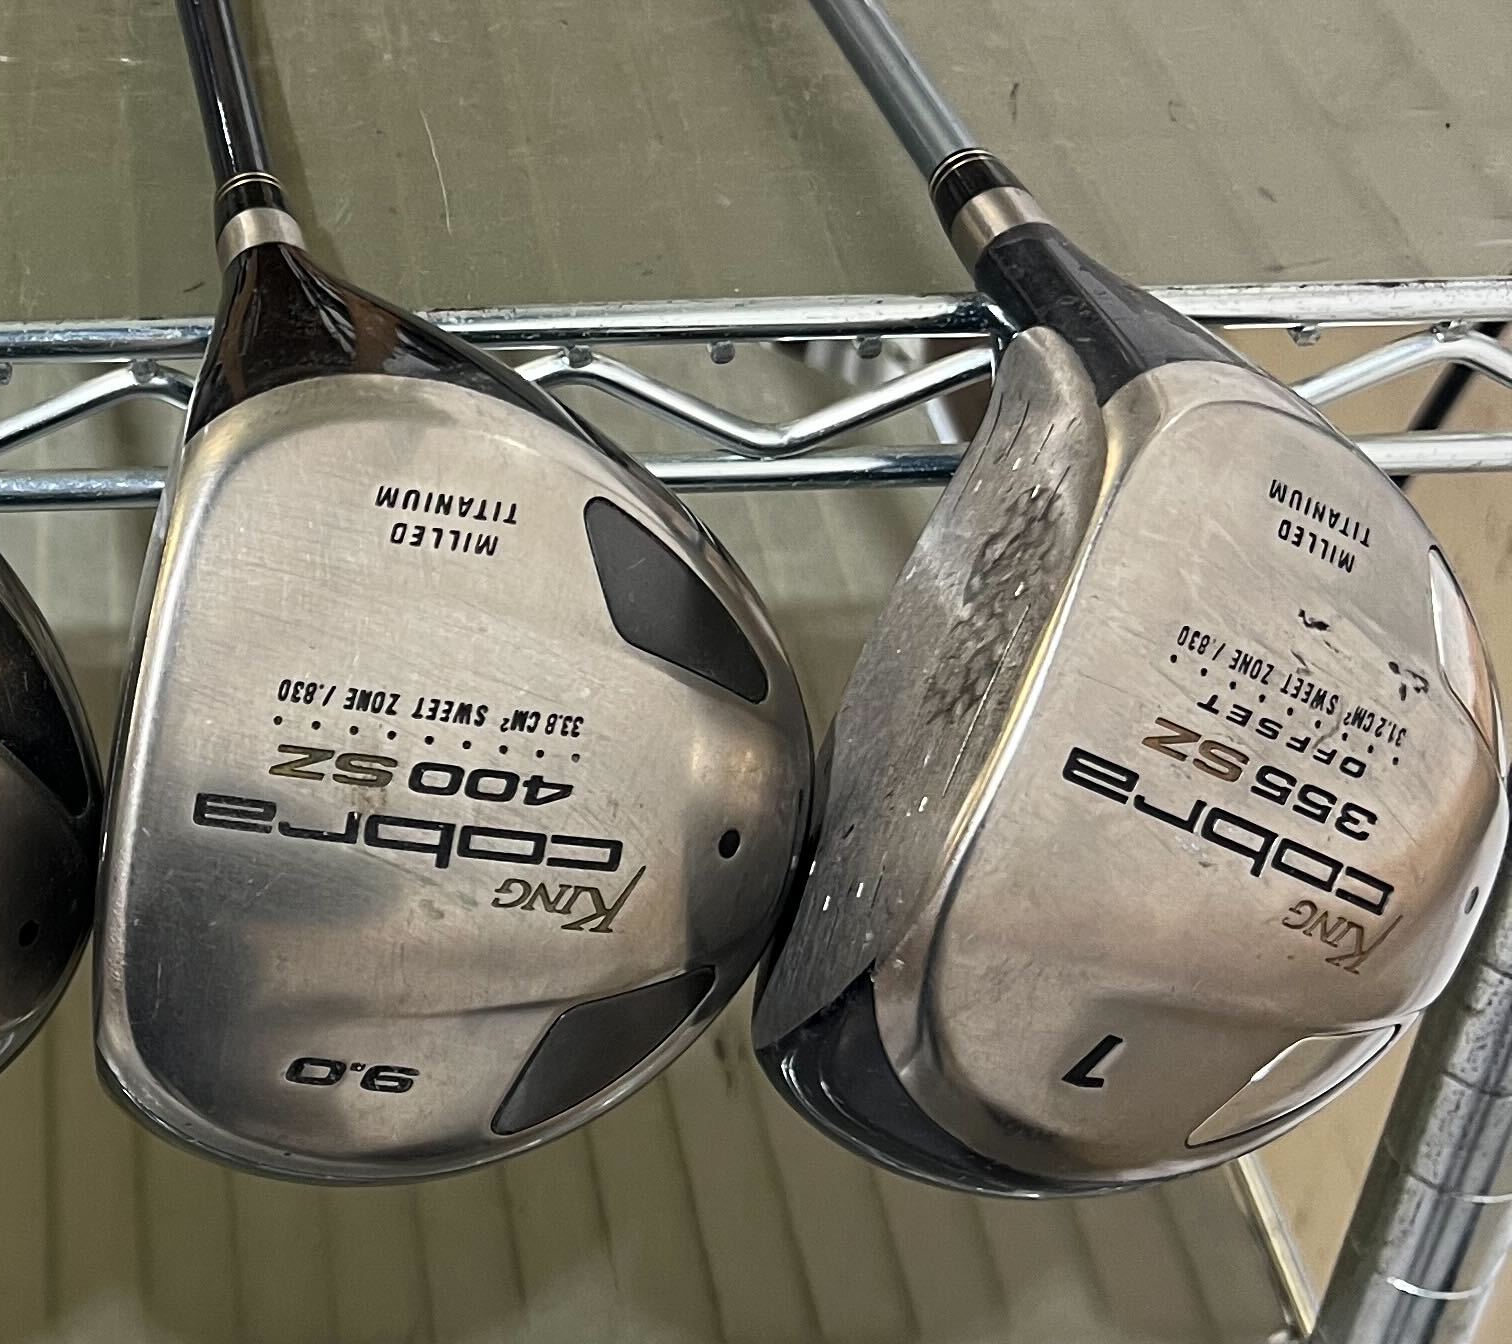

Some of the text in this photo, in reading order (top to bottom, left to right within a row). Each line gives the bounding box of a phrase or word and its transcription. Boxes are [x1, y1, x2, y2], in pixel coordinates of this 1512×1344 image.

[374, 485, 517, 526] TITANIUM
[1268, 479, 1370, 548] TITANIUM
[389, 522, 499, 556] MILLED
[1277, 518, 1355, 573] MILLED
[1228, 649, 1274, 685] ZONE
[343, 687, 401, 716] ZONE
[411, 697, 488, 727] SWEET
[1280, 674, 1339, 715] SWEET
[1196, 694, 1367, 778] OFFSET
[269, 744, 574, 806] 400 SZ
[193, 792, 624, 872] cobra
[1062, 746, 1394, 915] cobra
[287, 1056, 420, 1093] 9.0
[1061, 1034, 1123, 1089] 1
